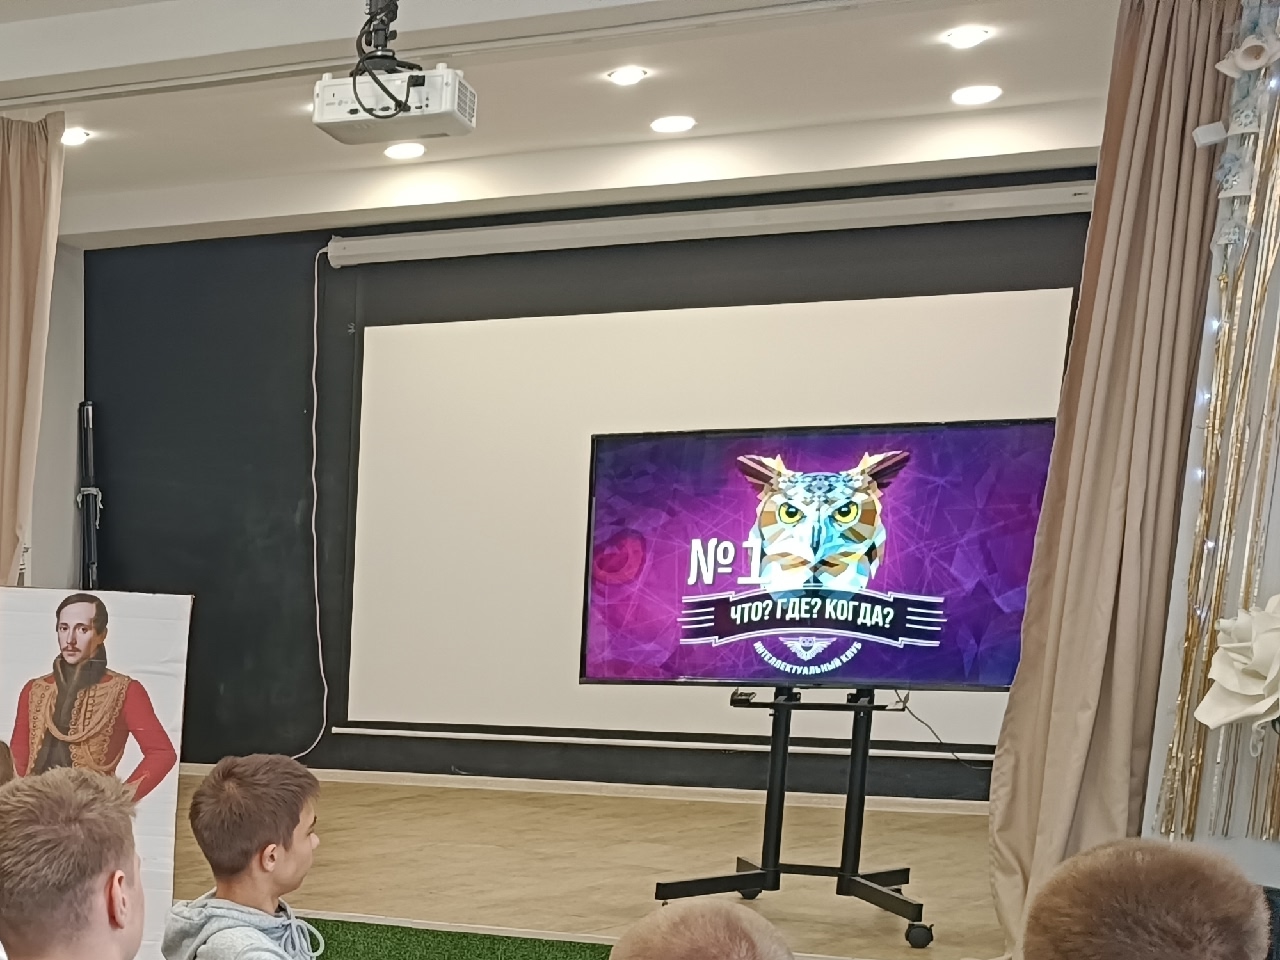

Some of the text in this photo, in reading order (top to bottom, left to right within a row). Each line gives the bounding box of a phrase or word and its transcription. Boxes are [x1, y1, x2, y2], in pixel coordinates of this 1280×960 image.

[730, 598, 894, 628] ЧТО? ГДЕ? КОГДА?
[753, 641, 862, 675] ИНТЕЛЛЕКТУАЛЬНЫЙ КЛУБ
